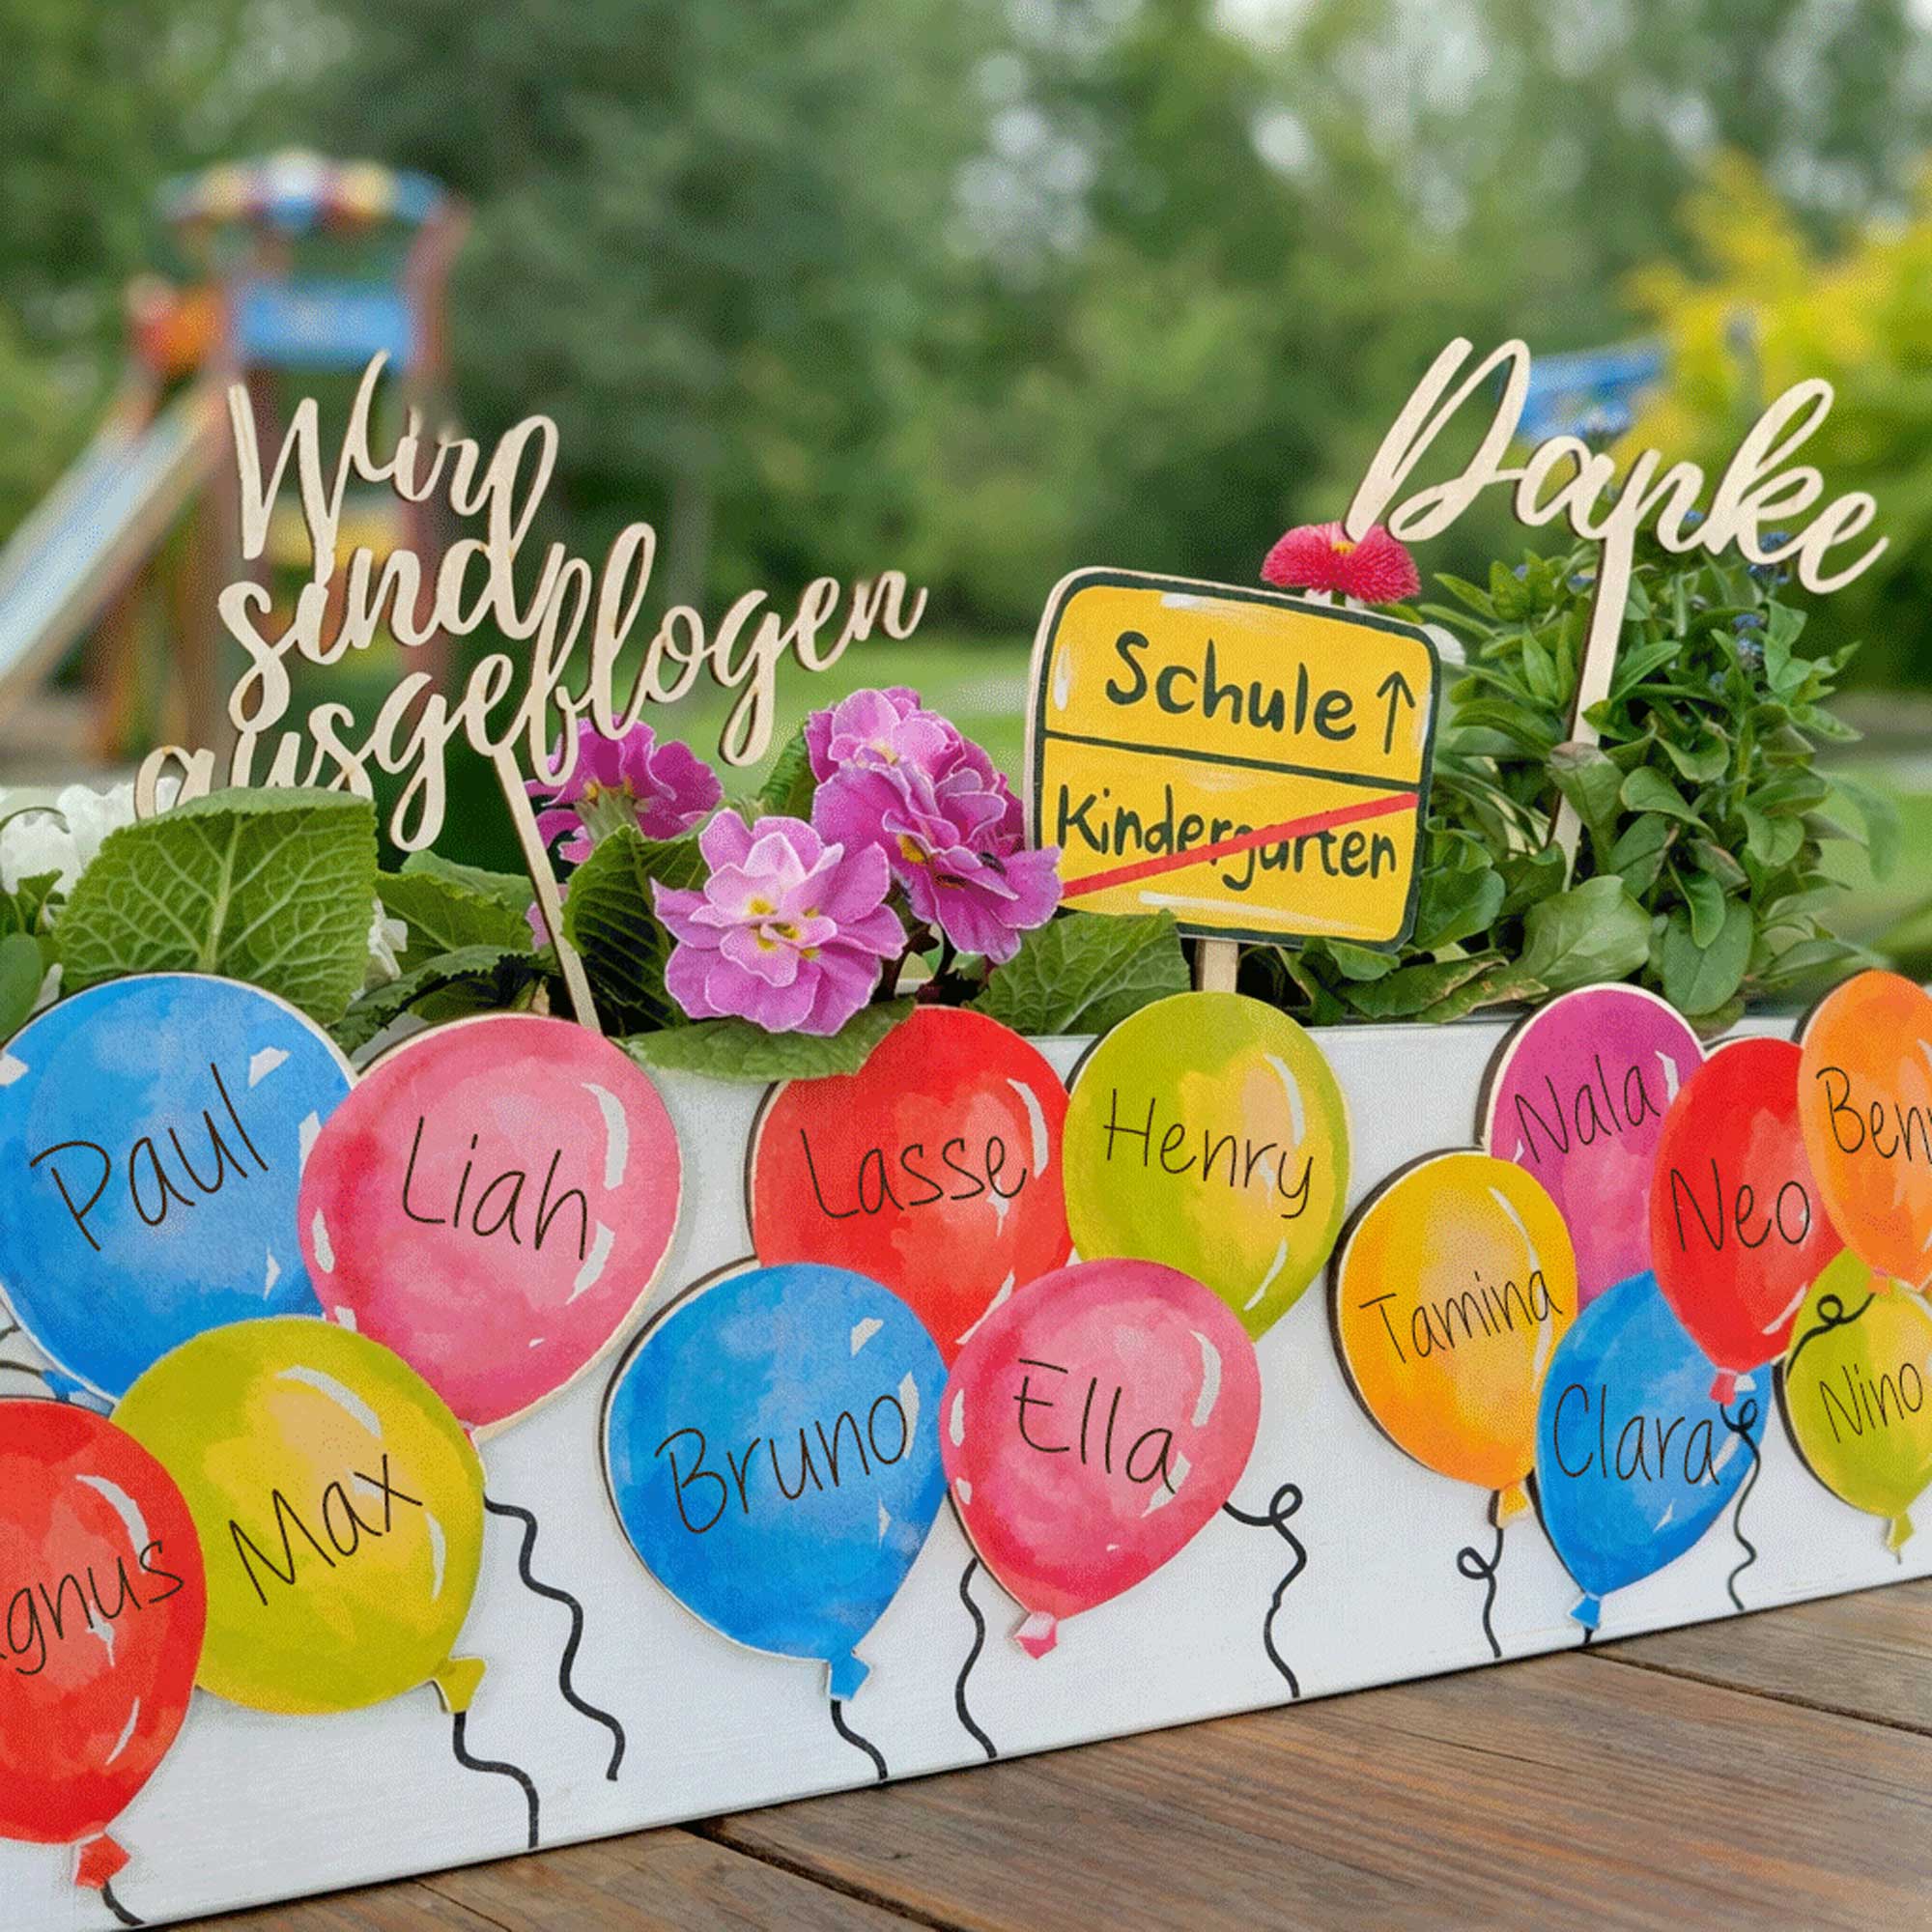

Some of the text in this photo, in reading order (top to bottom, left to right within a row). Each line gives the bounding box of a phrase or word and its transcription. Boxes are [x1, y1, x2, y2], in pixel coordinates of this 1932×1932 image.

[1345, 336, 1890, 596] Danke
[218, 413, 566, 732] sind
[1103, 631, 1358, 741] Schule
[1057, 782, 1397, 892] Kindergarten
[29, 1063, 269, 1251] Paul
[1102, 1088, 1315, 1218] Henry
[1514, 1054, 1662, 1164] Nala
[1815, 1065, 1932, 1165] Ben
[400, 1116, 589, 1260] Liah
[799, 1127, 1029, 1220] Lasse
[1669, 1158, 1812, 1253] Neo
[1358, 1268, 1565, 1365] Tamina
[1011, 1357, 1179, 1495] Ella
[1552, 1382, 1720, 1487] Clara
[1819, 1360, 1925, 1445] Nino
[653, 1394, 910, 1535] Bruno
[229, 1453, 423, 1606] Max
[0, 1540, 185, 1676] gnus
